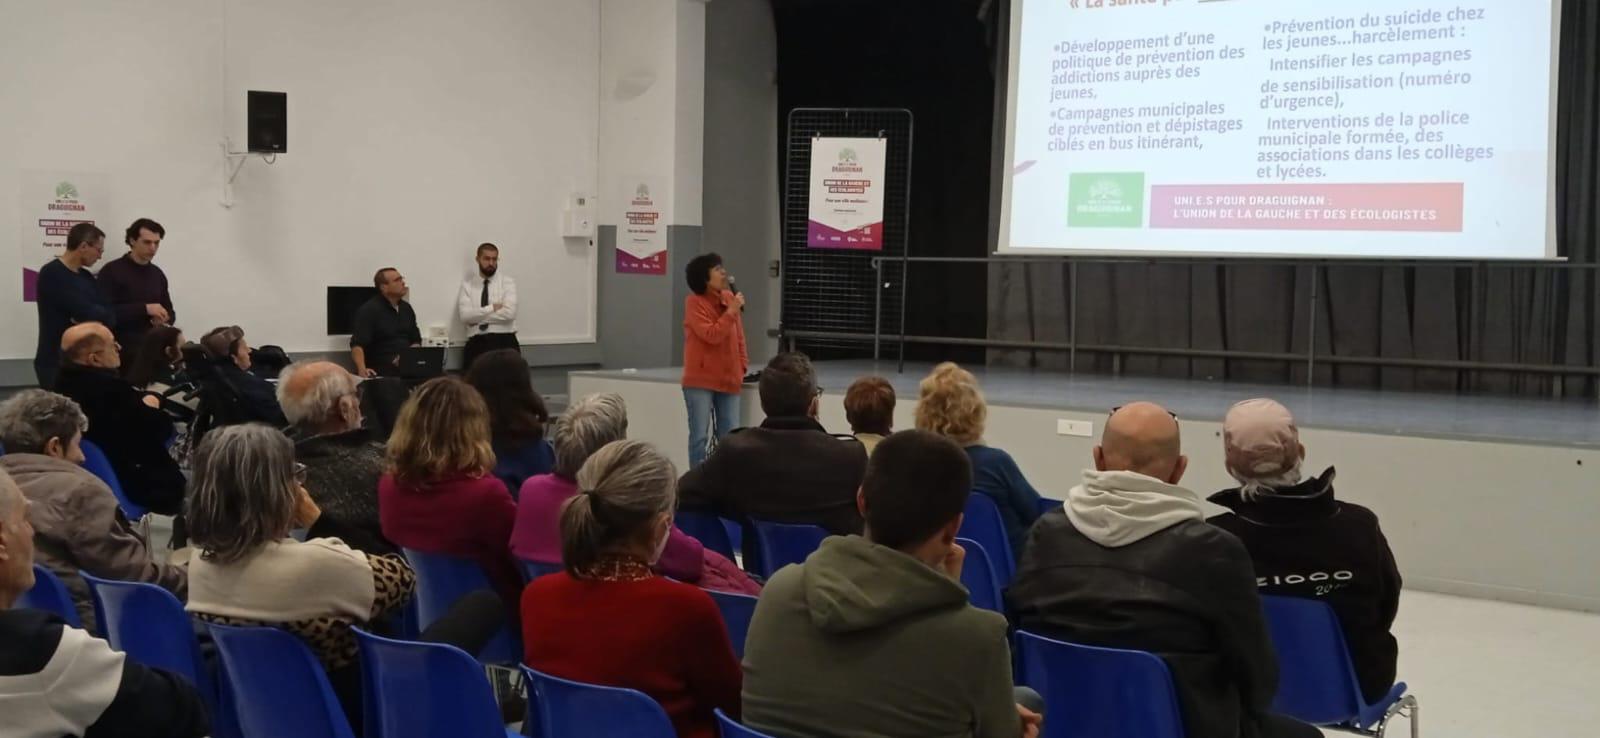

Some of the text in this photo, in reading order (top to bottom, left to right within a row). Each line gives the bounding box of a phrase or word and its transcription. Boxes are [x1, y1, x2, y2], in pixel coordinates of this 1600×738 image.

[1086, 0, 1103, 8] La
[1272, 6, 1485, 34] Prévention du suicide chez
[1061, 34, 1169, 53] Développement
[1262, 36, 1282, 50] les
[1052, 44, 1245, 72] politique de prévention des
[1270, 48, 1472, 71] Intensifier les campagnes
[1051, 64, 1201, 85] addictions auprès des
[1260, 71, 1472, 93] de sensibilisation (numéro
[1050, 87, 1097, 103] jeunes,
[1057, 101, 1225, 123] Campagnes municipales
[1267, 110, 1470, 130] Interventions de la police
[1048, 117, 1243, 138] de prévention et dépistages
[1047, 134, 1203, 152] ciblés en bus itinérant,
[1258, 128, 1443, 148] municipale formée, des
[1257, 144, 1494, 162] associations dans les collèges
[1257, 163, 1326, 181] et lycées.
[1216, 196, 1246, 205] POUR
[1249, 196, 1325, 206] DRAGUIGNAN
[1220, 209, 1234, 218] DE
[1237, 209, 1252, 218] LA
[1256, 209, 1300, 219] GAUCHE
[1305, 209, 1320, 219] ET
[1323, 209, 1346, 219] DES
[1350, 208, 1437, 220] ÉCOLOGISTES
